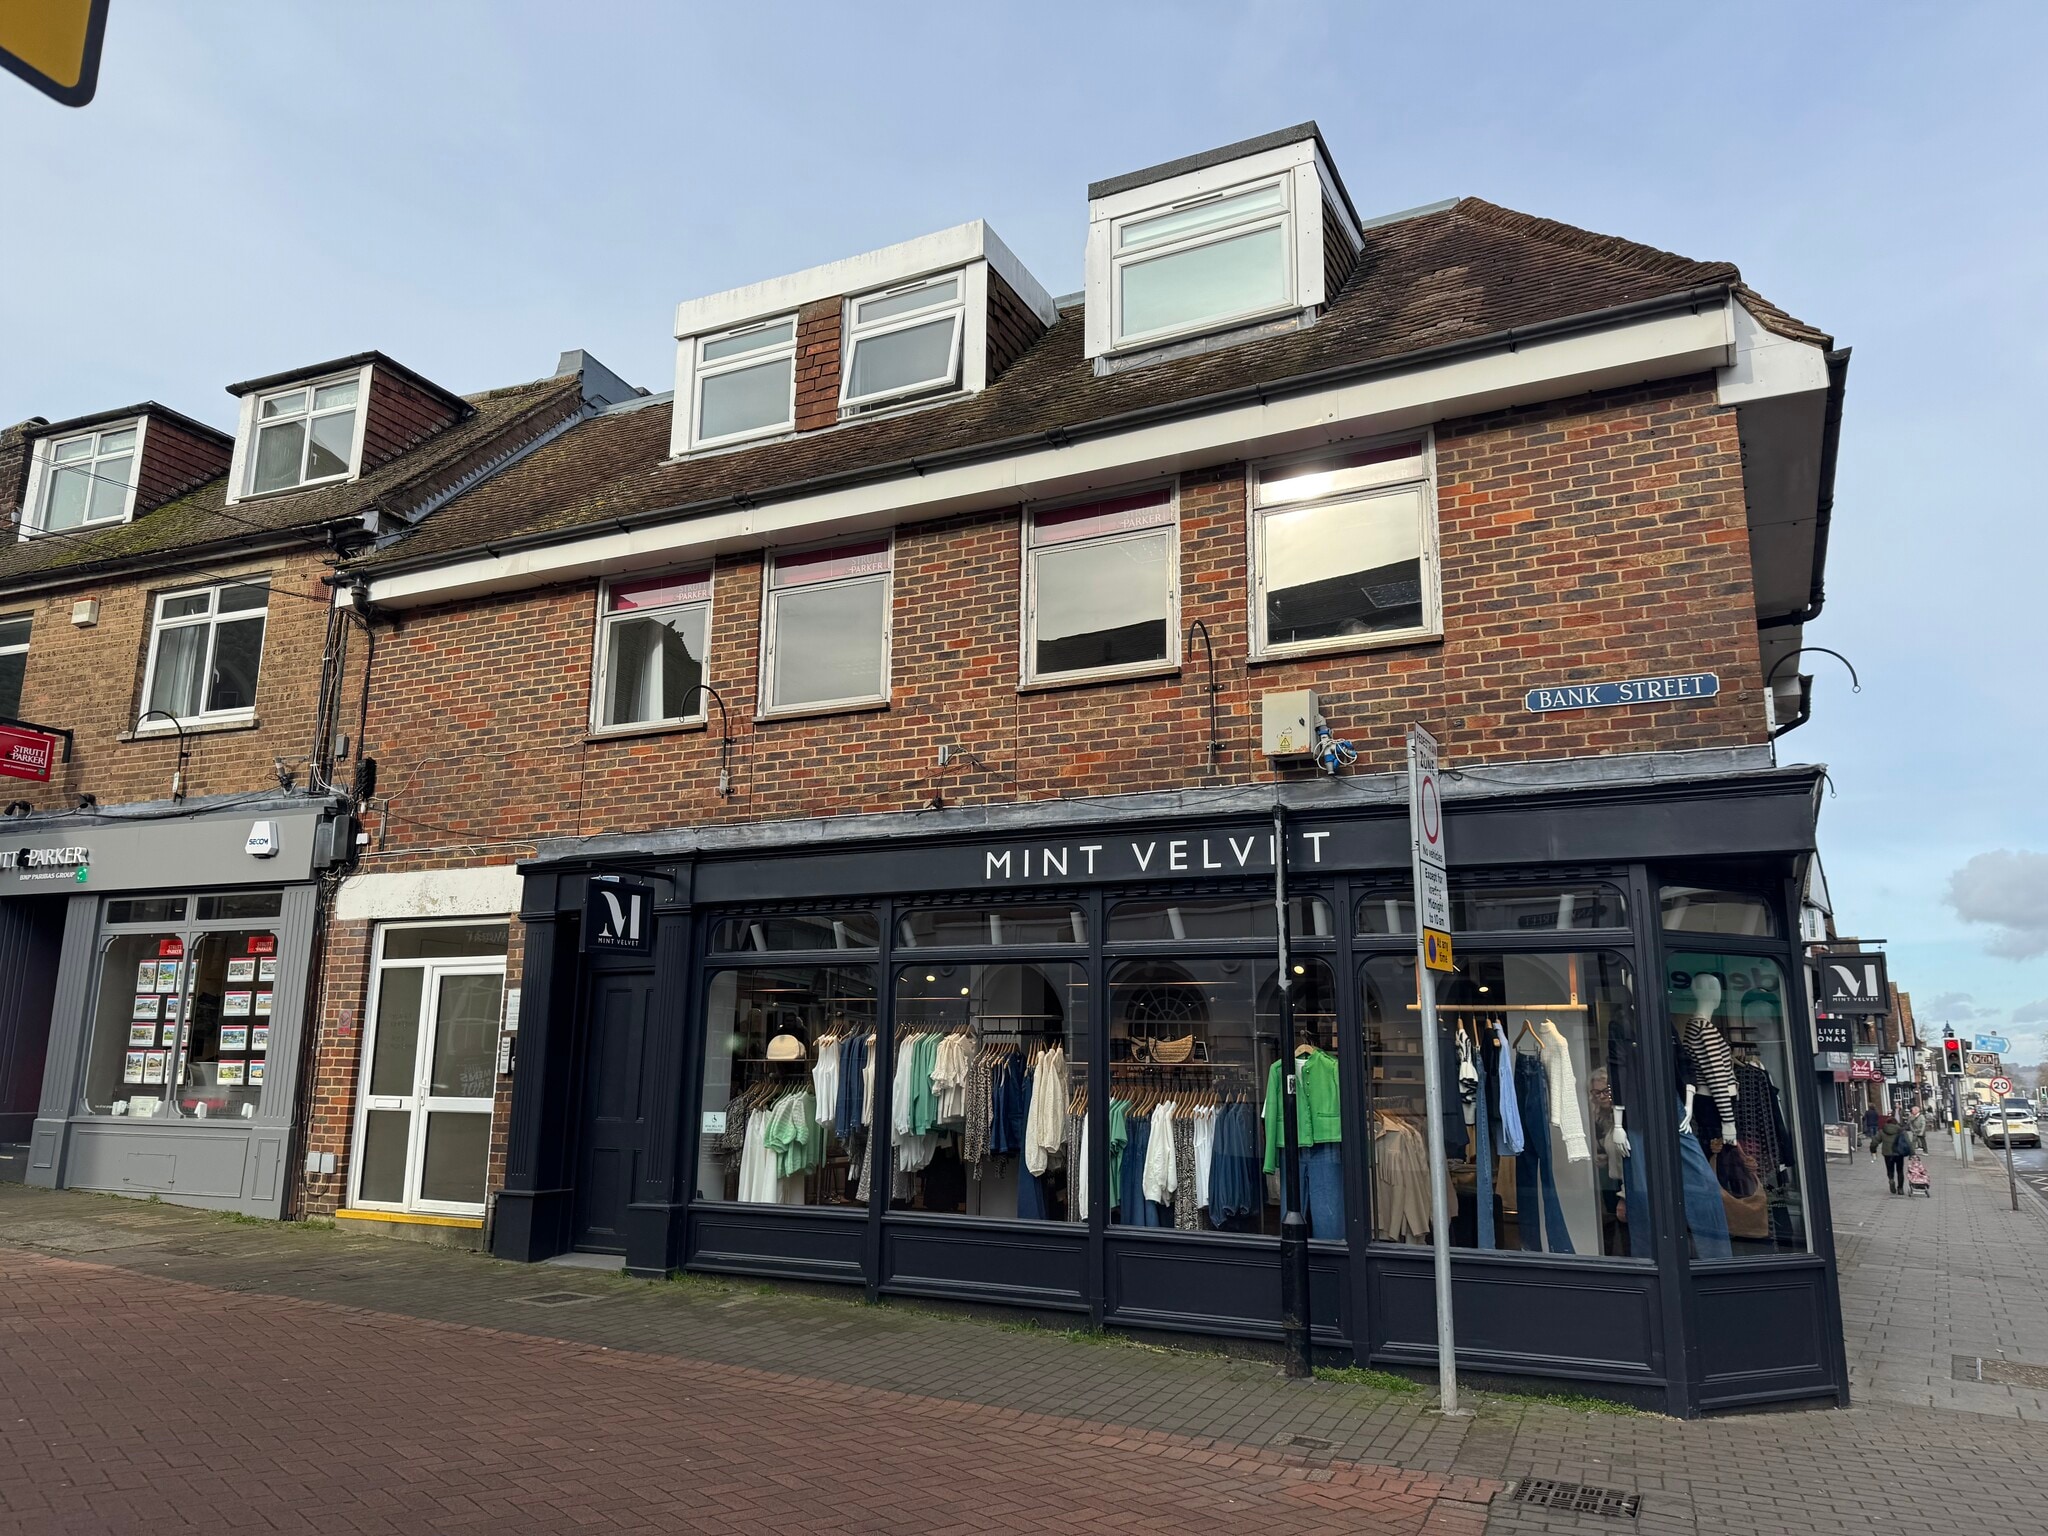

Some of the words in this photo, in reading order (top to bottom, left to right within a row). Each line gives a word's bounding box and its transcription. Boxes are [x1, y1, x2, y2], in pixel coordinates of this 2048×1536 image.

[1123, 513, 1162, 528] PARKER
[850, 562, 883, 573] PARKER
[677, 590, 707, 600] PARKER
[1539, 687, 1601, 709] BANK
[1619, 676, 1704, 701] STREET
[13, 745, 45, 757] STRUTT
[12, 753, 44, 765] PARKER
[1420, 751, 1435, 776] ZONE
[249, 838, 269, 846] SECOM
[0, 851, 20, 868] TT
[26, 847, 88, 867] PARKER
[986, 845, 1102, 880] MINT
[1429, 849, 1443, 863] vehicles
[1424, 867, 1437, 882] Except
[1428, 897, 1444, 913] Midnight
[598, 891, 641, 940] M
[617, 939, 639, 947] VELVET
[1440, 952, 1448, 963] time
[1829, 965, 1879, 997] M
[1993, 1081, 2008, 1090] 20
